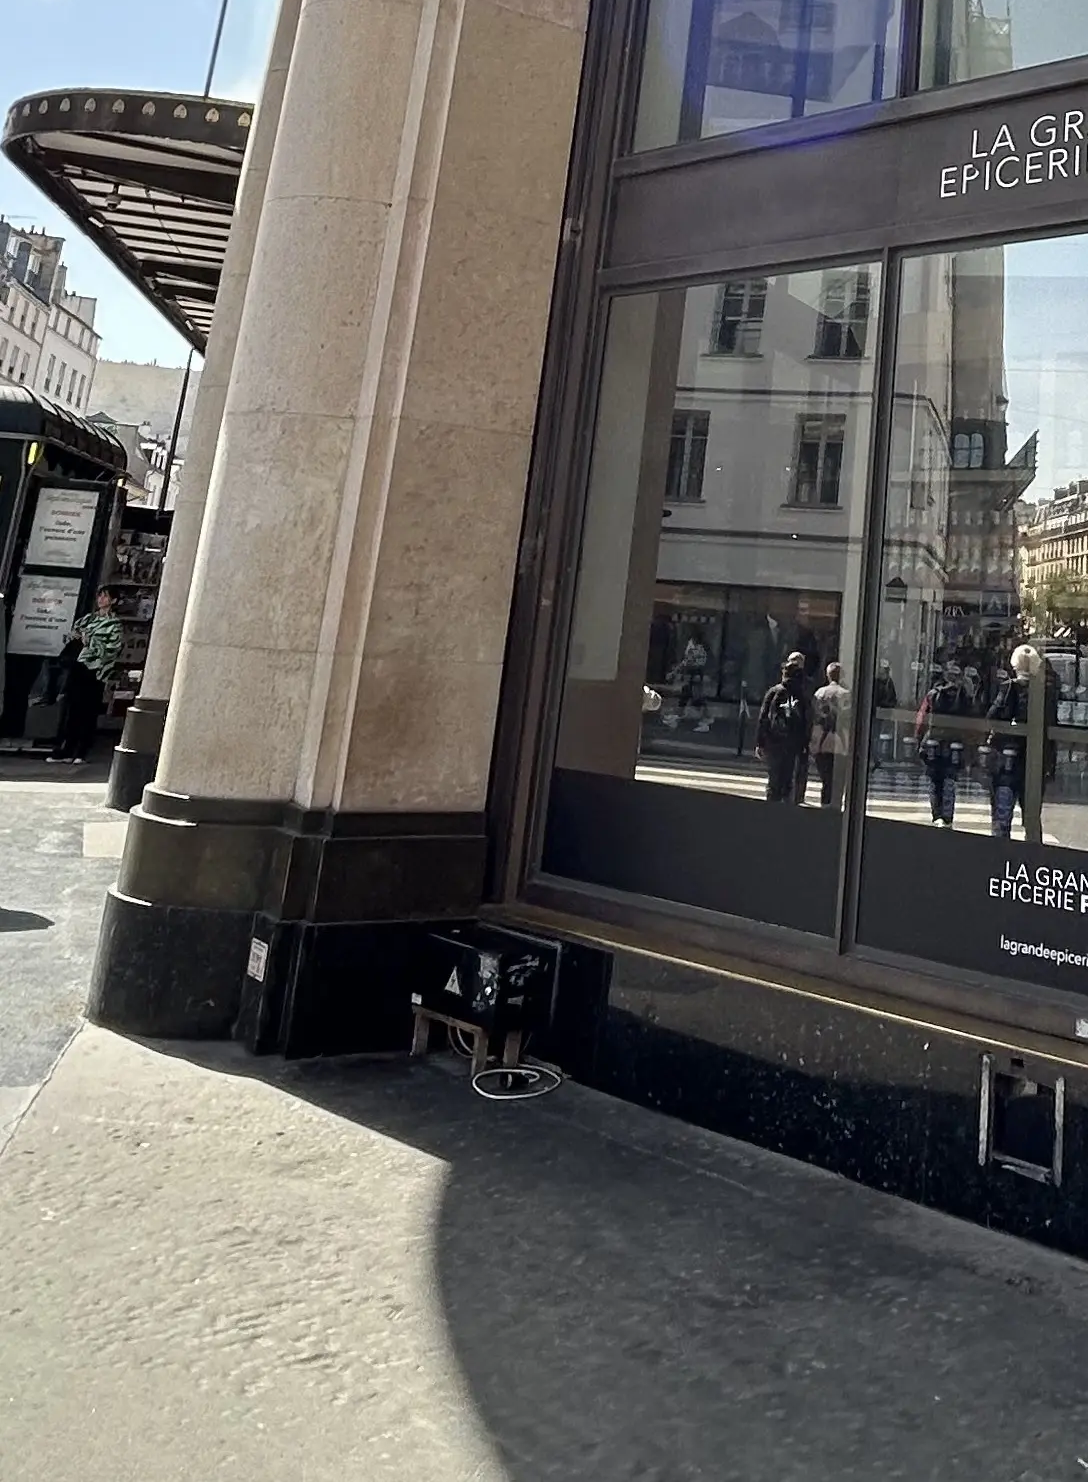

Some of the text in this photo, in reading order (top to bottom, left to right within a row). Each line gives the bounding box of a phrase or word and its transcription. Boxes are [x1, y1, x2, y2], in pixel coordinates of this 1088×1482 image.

[971, 124, 1016, 160] LA
[1005, 861, 1029, 882] LA
[989, 878, 1074, 911] EPICERIE
